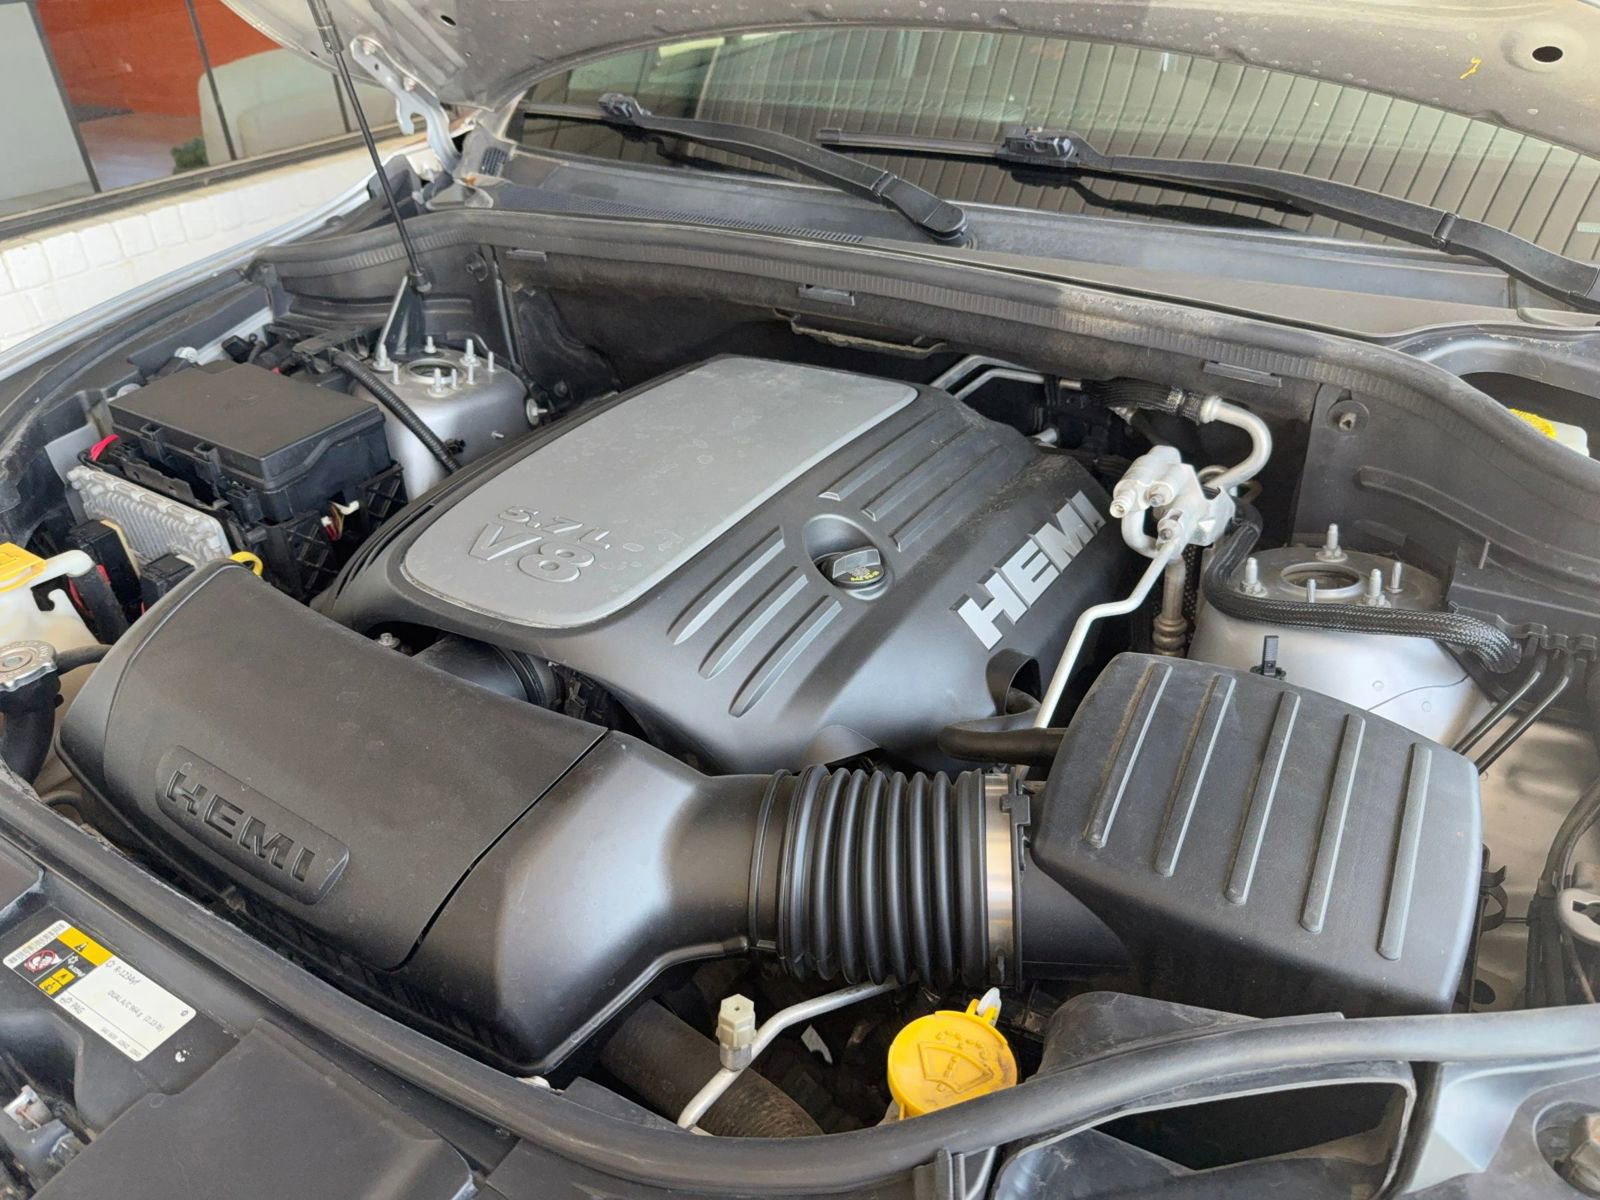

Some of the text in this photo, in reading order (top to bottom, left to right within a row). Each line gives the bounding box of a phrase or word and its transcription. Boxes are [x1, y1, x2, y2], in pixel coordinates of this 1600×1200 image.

[467, 521, 596, 583] V8
[955, 490, 1106, 650] HEMI
[164, 769, 316, 883] HEMI
